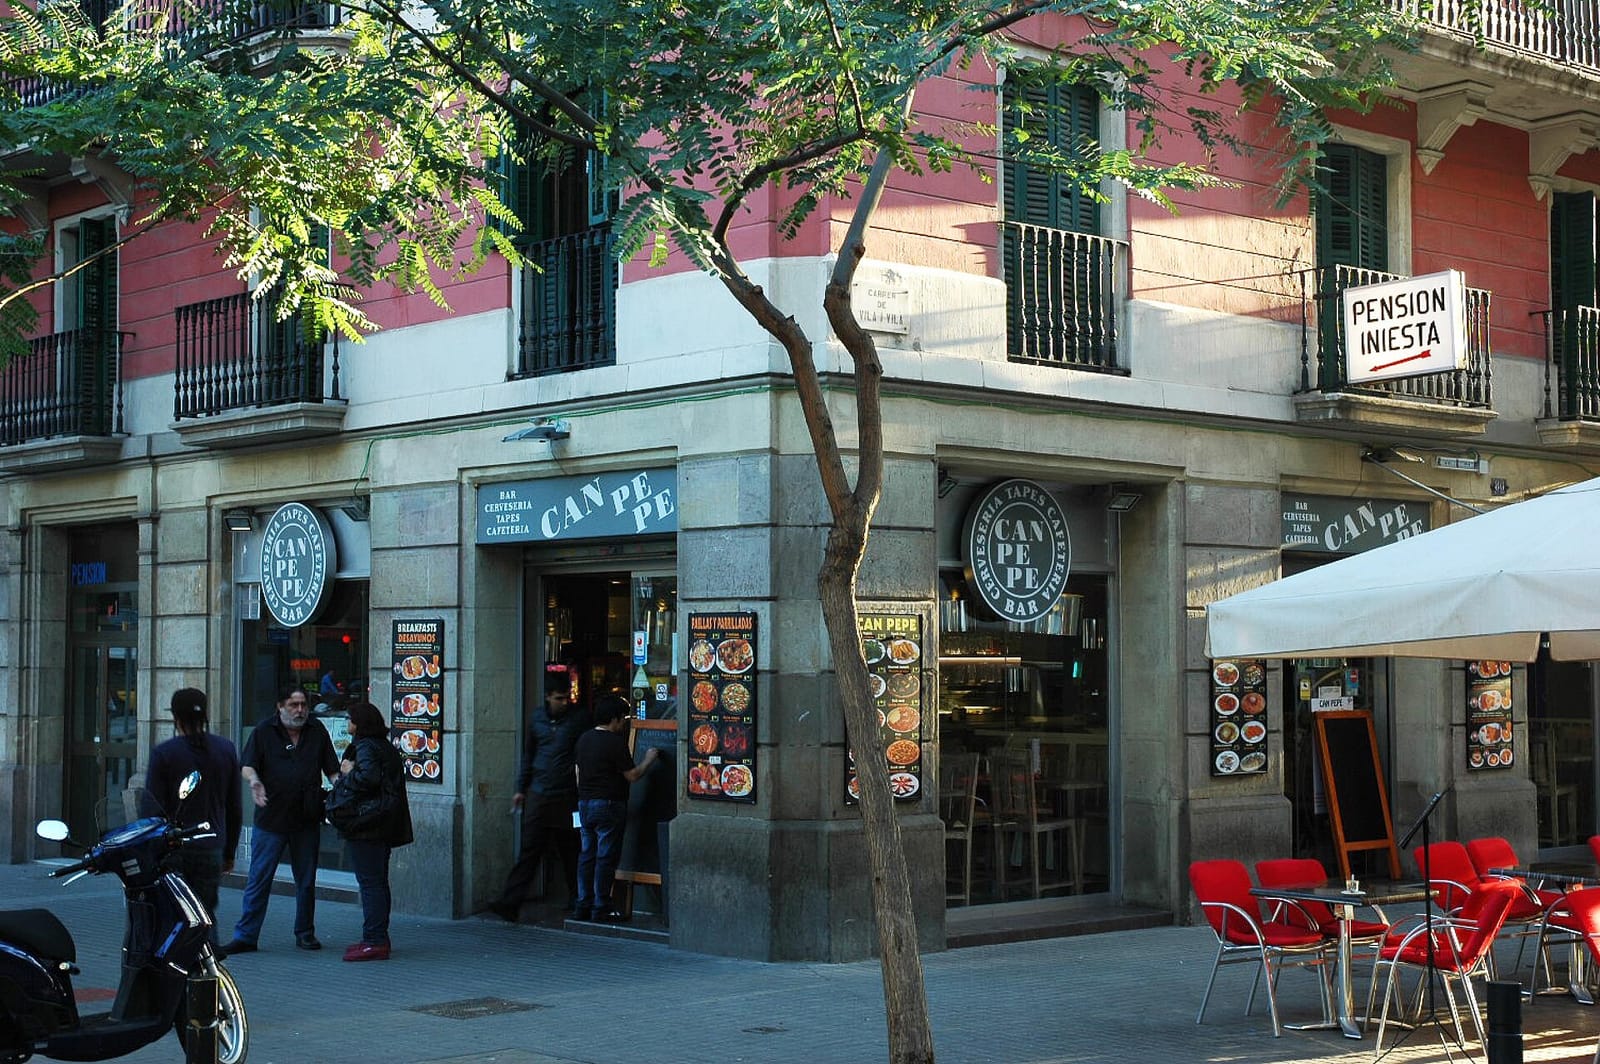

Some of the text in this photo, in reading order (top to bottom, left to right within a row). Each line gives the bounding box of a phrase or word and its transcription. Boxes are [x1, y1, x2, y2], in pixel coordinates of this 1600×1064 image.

[877, 301, 887, 309] DE
[1352, 287, 1445, 325] PENSION
[1361, 320, 1440, 355] INIESTA
[500, 491, 517, 500] BAR
[541, 472, 652, 538] CAN PE
[1005, 486, 1045, 506] TAPES
[280, 508, 308, 525] TAPES
[484, 501, 532, 513] CERVESERIA
[632, 489, 675, 533] PE
[496, 514, 520, 524] TAPES
[1324, 501, 1410, 551] CAN PE
[486, 524, 530, 536] CAFETERIA
[994, 519, 1044, 541] CAN
[275, 538, 308, 558] CAN
[976, 496, 1004, 600] CERVESERIA
[997, 543, 1030, 565] PE
[1041, 507, 1066, 600] CAFETERIA
[263, 521, 281, 608] CERVESERIA
[276, 559, 298, 578] PE
[305, 523, 323, 606] CAFETERIA
[282, 578, 304, 598] PE
[1007, 567, 1039, 589] PE
[281, 607, 304, 621] BAR
[1004, 598, 1039, 616] BAR
[397, 623, 437, 632] BREAKFASTS
[886, 617, 917, 631] PEPE
[398, 633, 436, 643] DESAYUNOS
